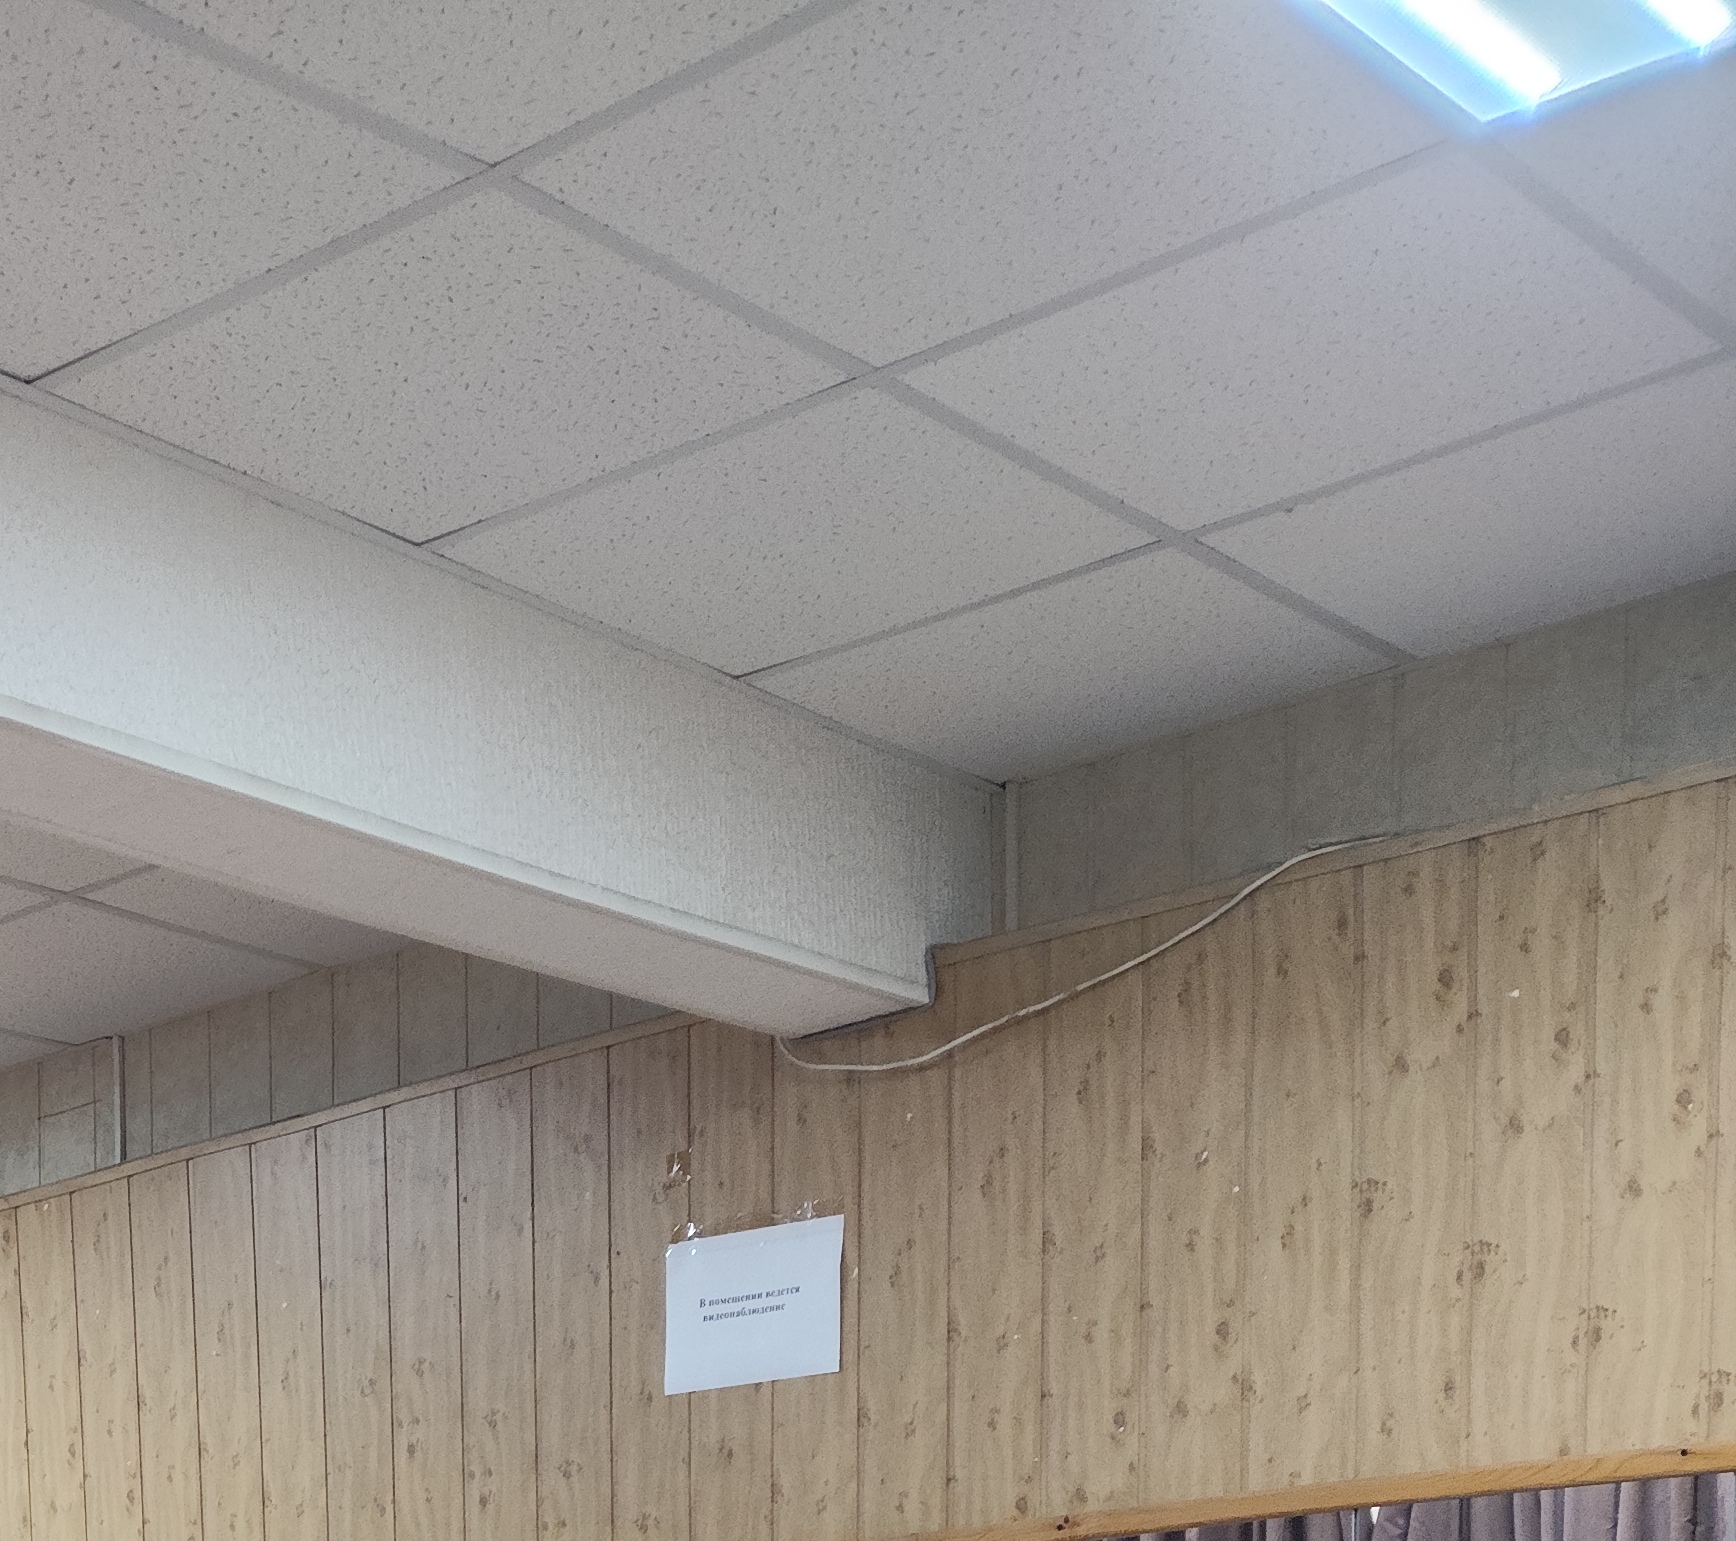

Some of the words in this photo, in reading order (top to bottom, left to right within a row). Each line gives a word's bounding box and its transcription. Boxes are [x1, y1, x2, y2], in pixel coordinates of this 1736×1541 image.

[699, 1298, 706, 1308] В
[708, 1291, 763, 1307] помещении
[765, 1285, 801, 1300] ведется
[702, 1302, 786, 1322] видеонаблюдение
